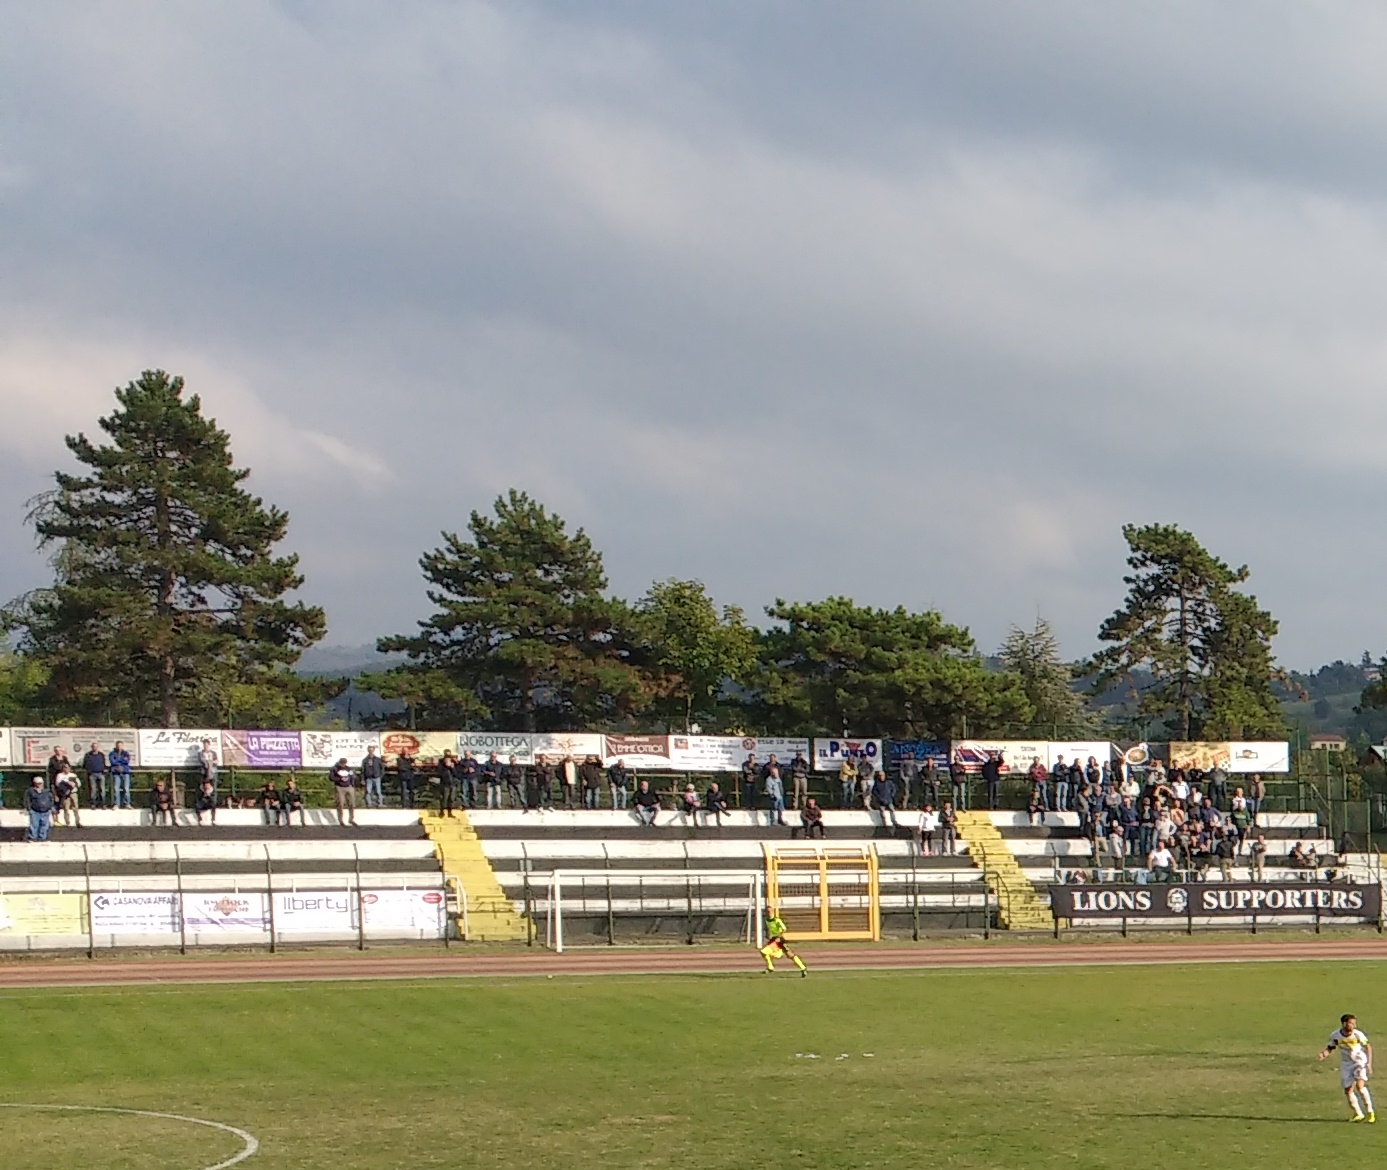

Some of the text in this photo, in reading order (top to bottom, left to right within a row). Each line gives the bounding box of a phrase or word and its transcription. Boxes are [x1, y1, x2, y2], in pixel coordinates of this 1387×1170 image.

[248, 737, 300, 750] LA PIAZZETTA
[283, 896, 349, 912] liberty
[1072, 890, 1362, 911] LIONS SUPPORTERS
